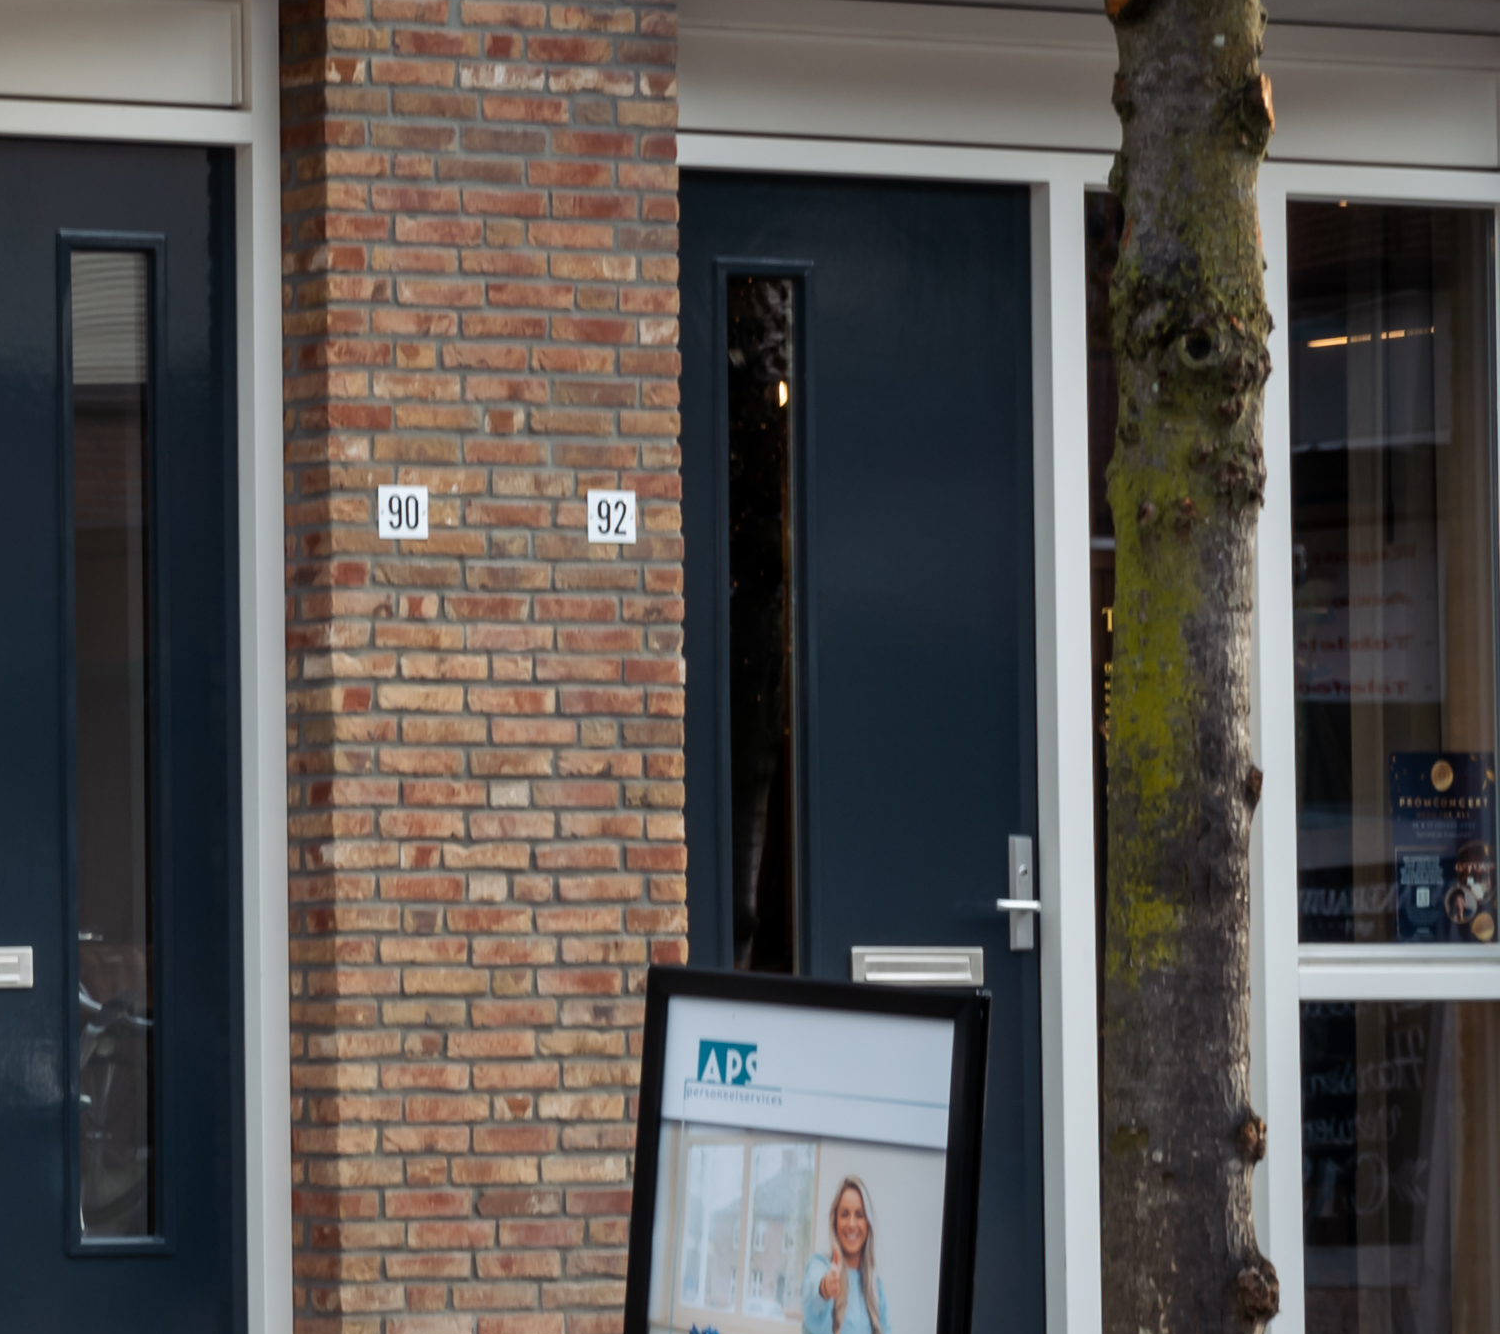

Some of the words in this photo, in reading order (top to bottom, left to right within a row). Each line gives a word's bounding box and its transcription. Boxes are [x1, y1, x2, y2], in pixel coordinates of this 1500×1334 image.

[388, 494, 419, 530] 90
[597, 499, 628, 535] 92
[699, 1046, 757, 1086] APS
[686, 1088, 782, 1107] personeelservices
